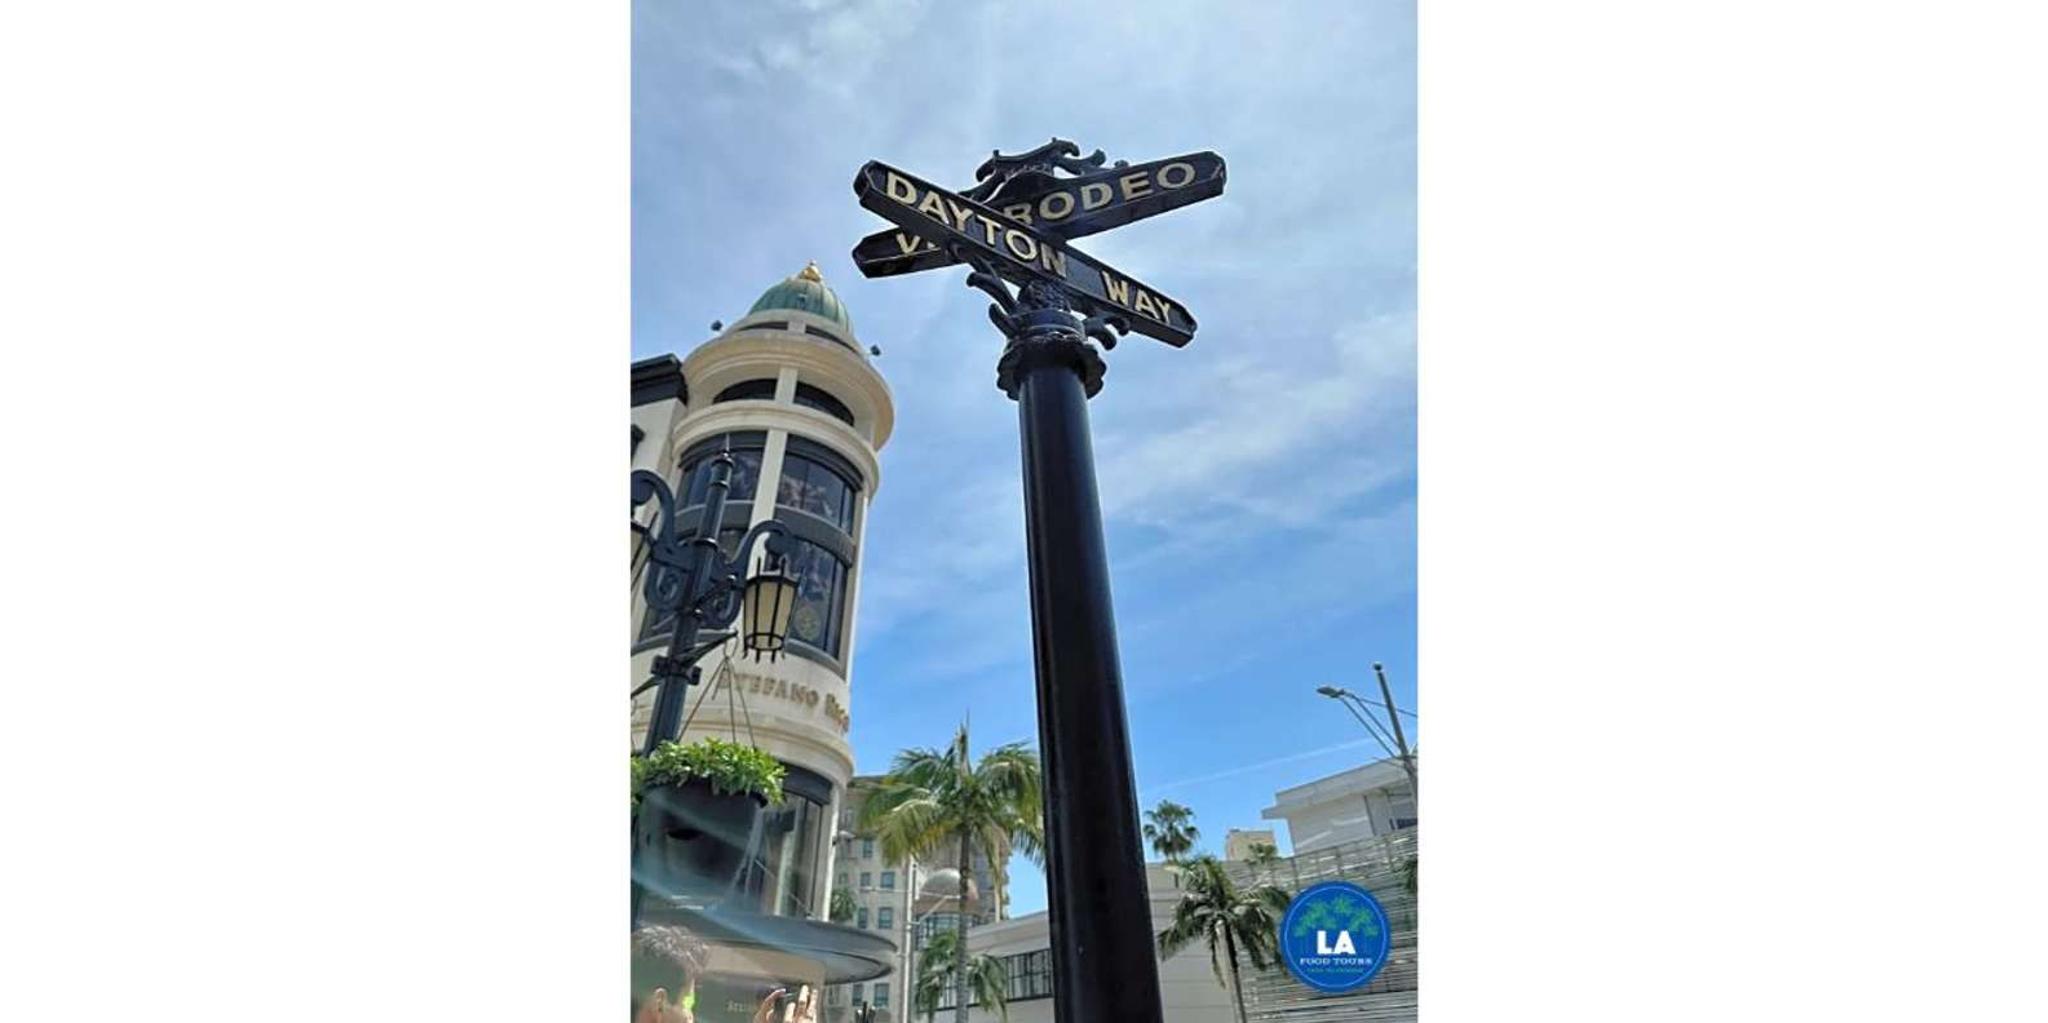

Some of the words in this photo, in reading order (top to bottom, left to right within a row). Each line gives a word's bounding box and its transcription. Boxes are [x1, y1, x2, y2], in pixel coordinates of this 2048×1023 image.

[886, 171, 1067, 278] DAYTON
[1101, 269, 1172, 324] WAY
[1003, 162, 1197, 226] RODEO
